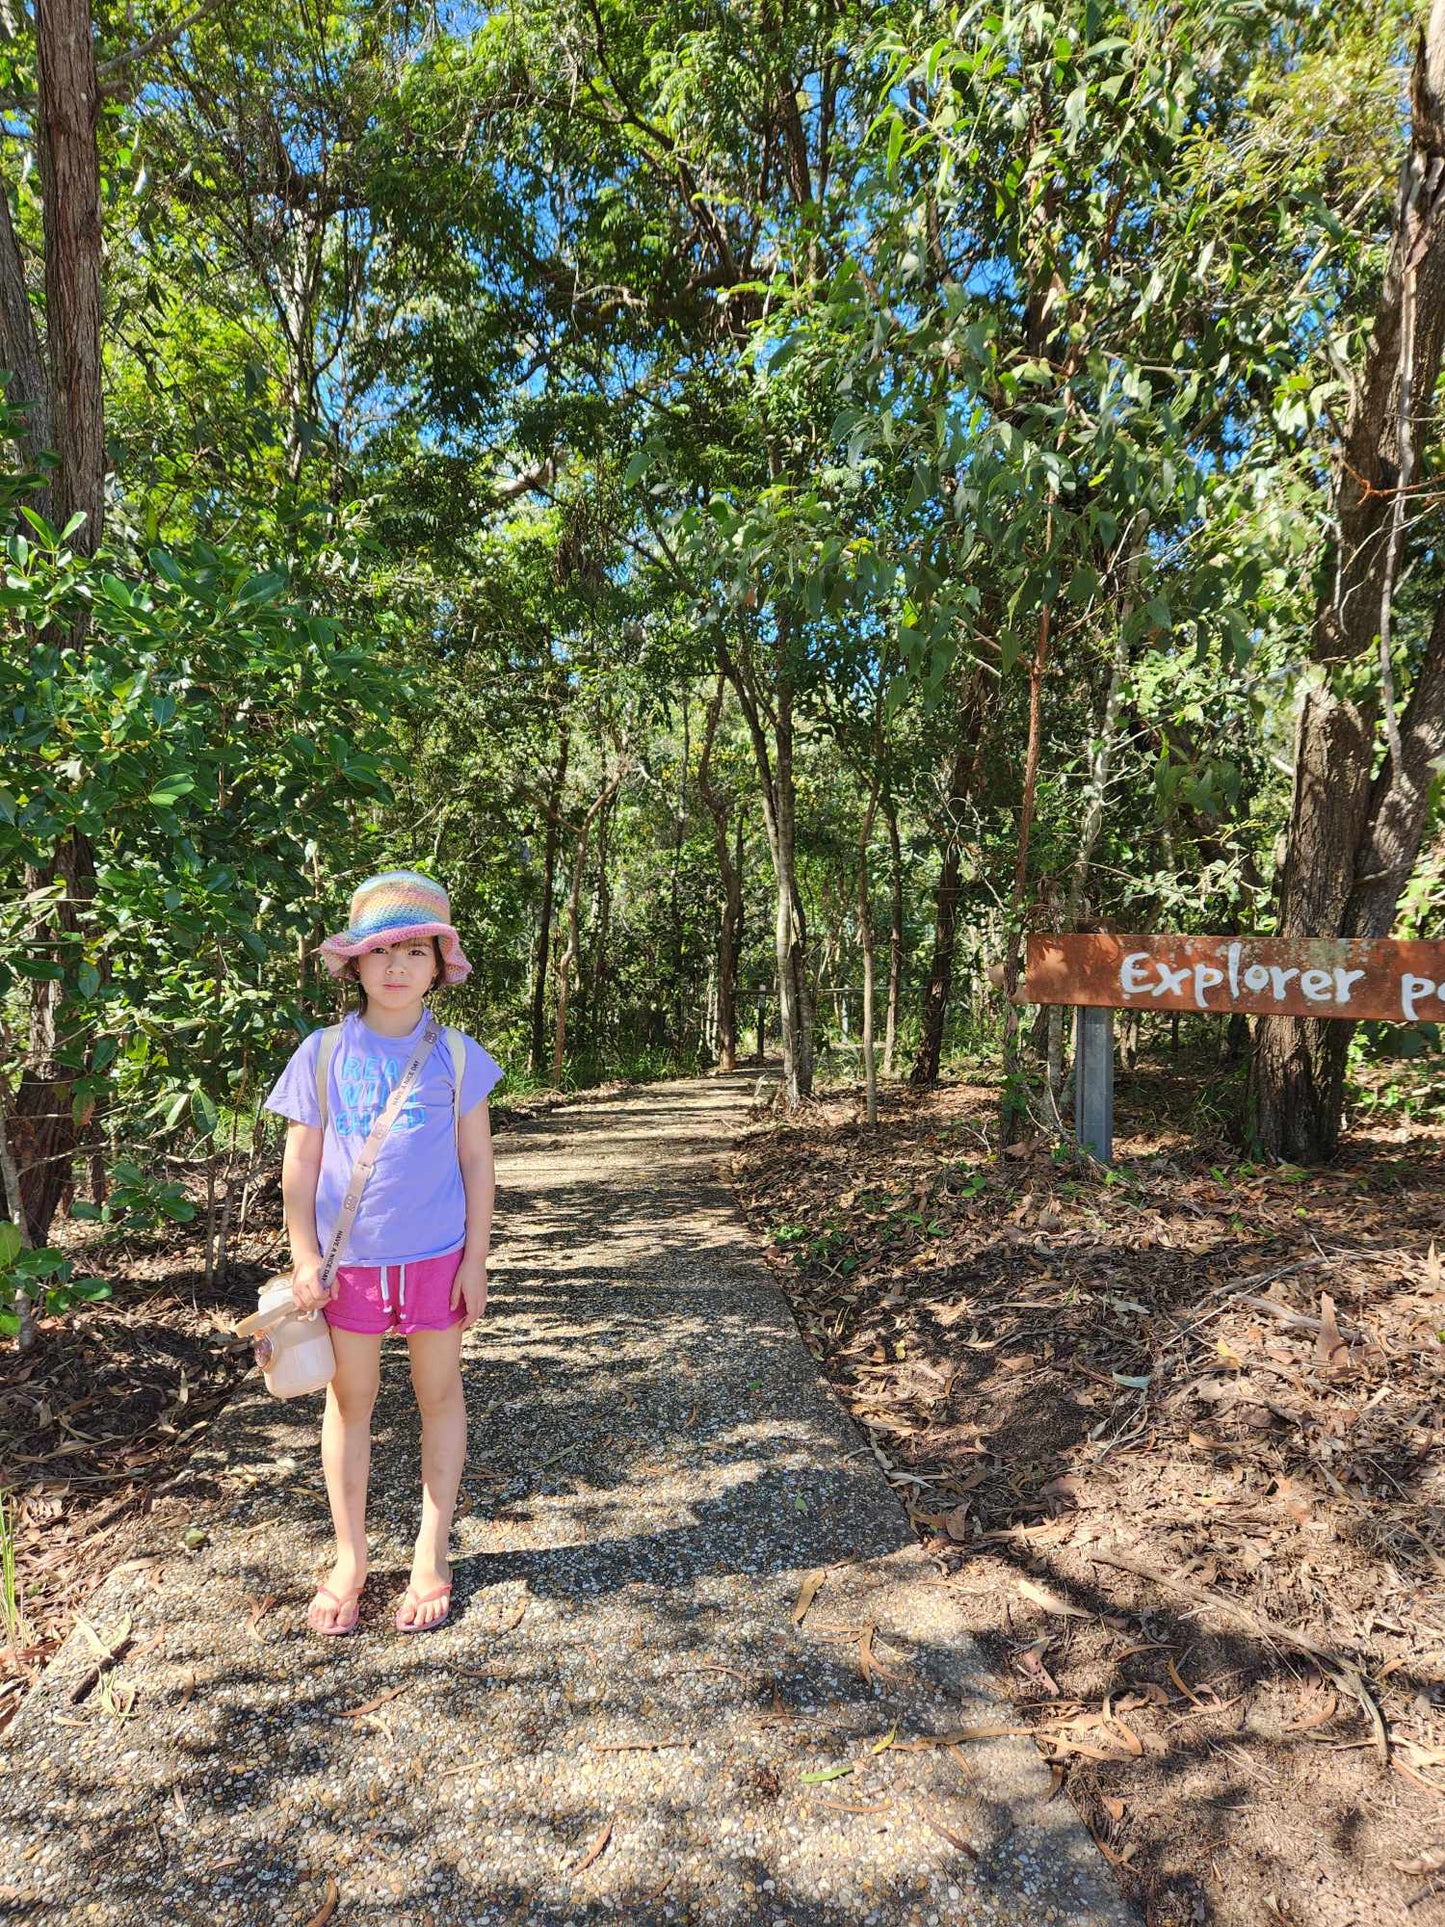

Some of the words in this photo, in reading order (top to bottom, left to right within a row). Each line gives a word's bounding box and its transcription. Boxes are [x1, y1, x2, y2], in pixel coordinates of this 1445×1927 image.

[1121, 942, 1366, 1008] Explorer
[343, 1055, 399, 1084] REA
[333, 1231, 343, 1246] HAVE
[325, 1254, 335, 1269] NICE
[321, 1269, 330, 1281] DAY
